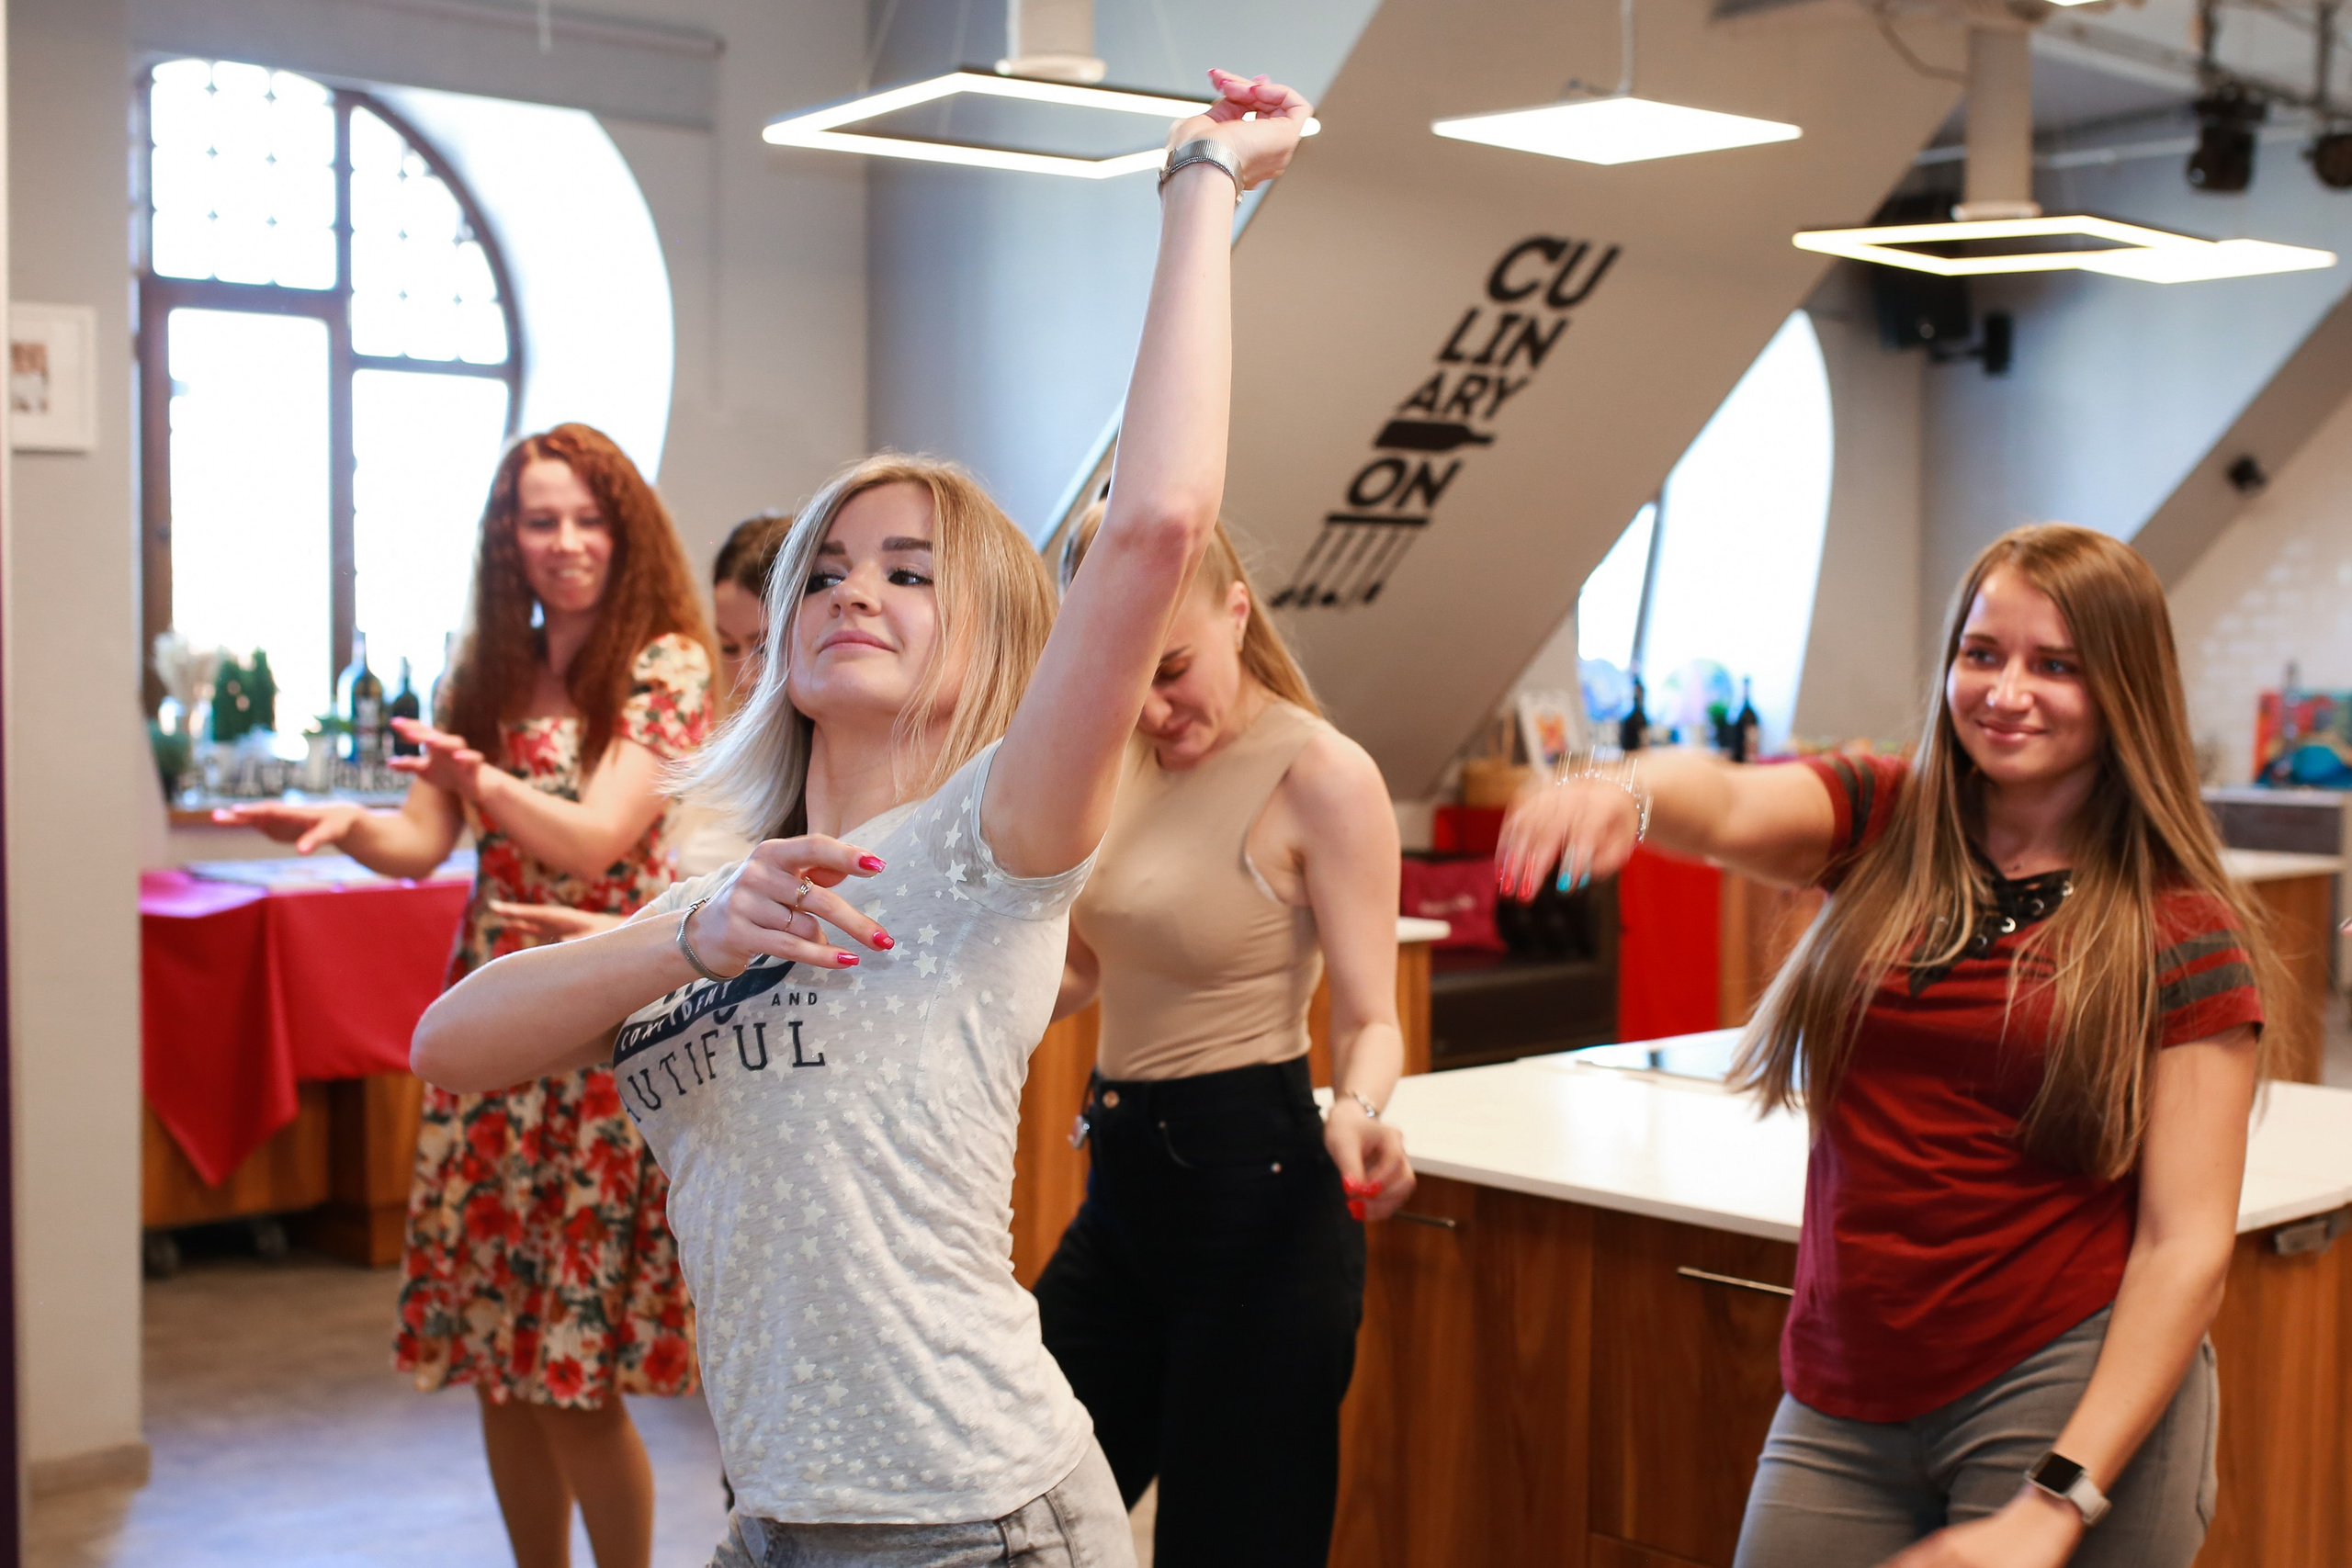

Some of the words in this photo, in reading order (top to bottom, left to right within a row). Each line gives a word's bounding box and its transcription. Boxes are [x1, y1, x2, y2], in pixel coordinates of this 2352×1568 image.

[1486, 234, 1622, 310] CU
[1435, 307, 1568, 370] LIN
[1393, 371, 1532, 421] ARY
[1345, 457, 1464, 510] ON
[771, 992, 818, 1007] AND
